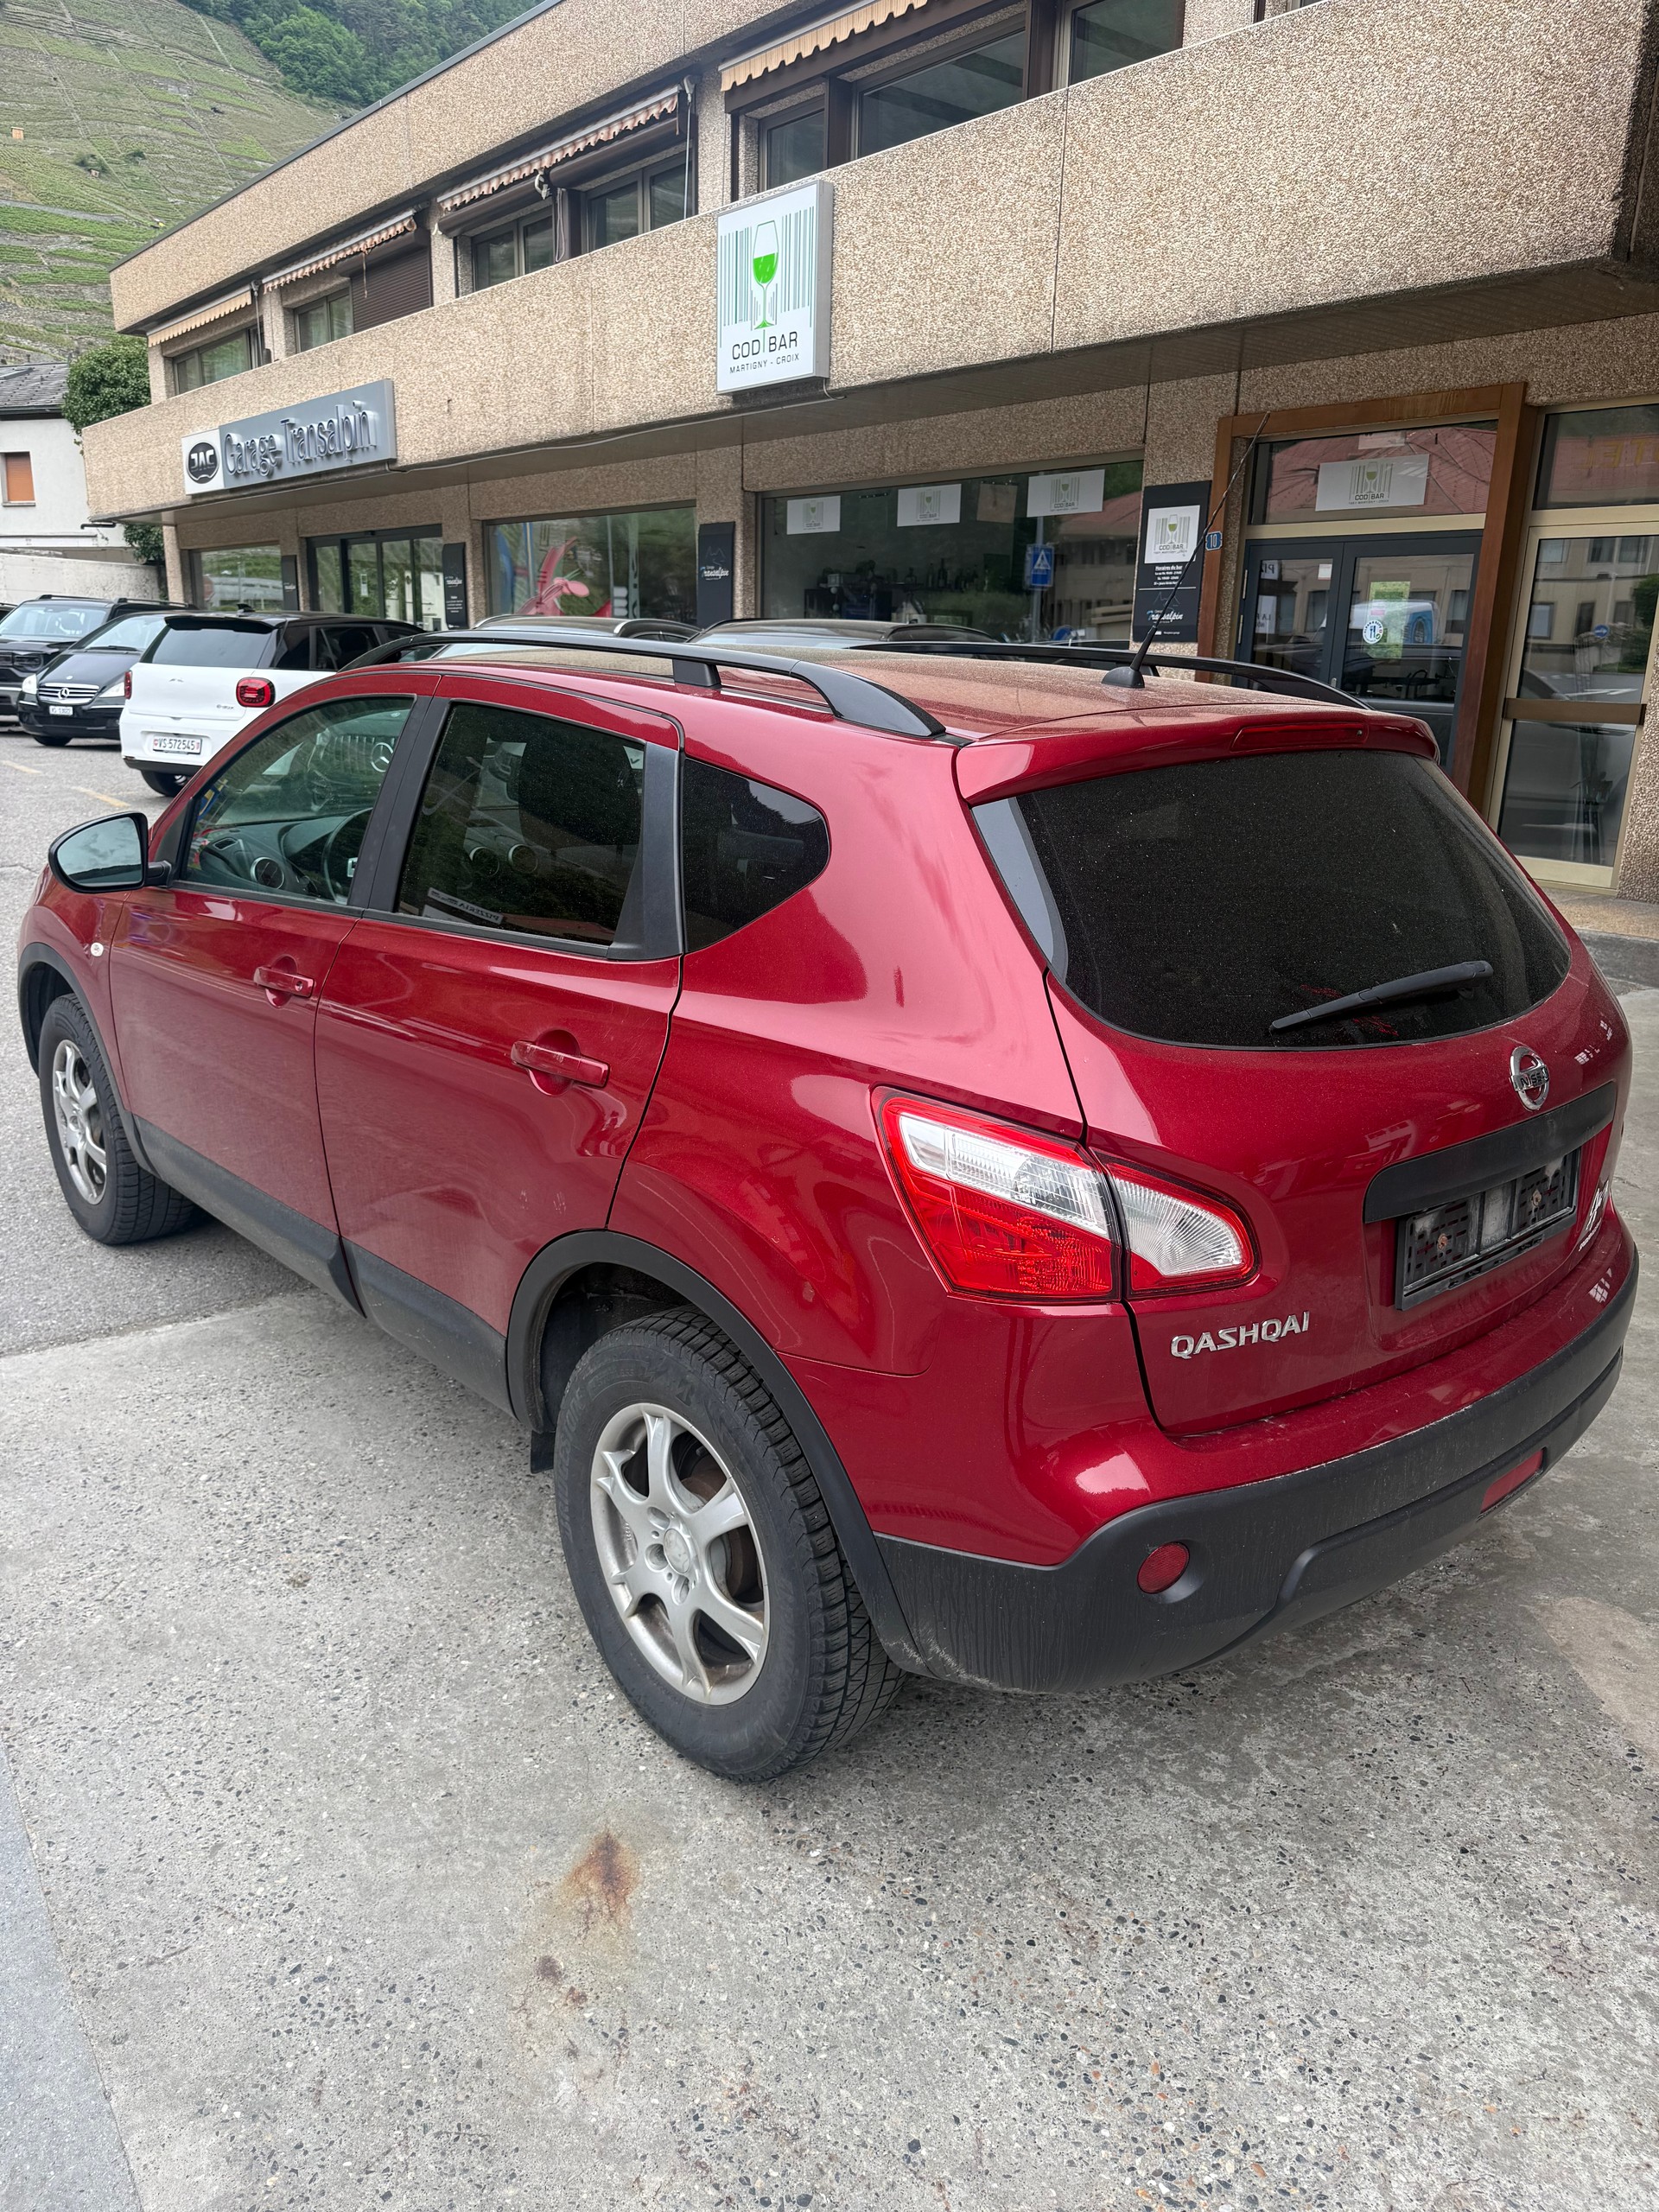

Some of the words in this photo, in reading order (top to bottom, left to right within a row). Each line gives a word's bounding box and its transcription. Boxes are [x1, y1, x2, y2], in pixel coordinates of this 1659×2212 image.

[732, 339, 760, 360] COD
[768, 331, 798, 353] BAR
[729, 359, 767, 373] MARTIGNY
[776, 353, 799, 365] CROIX
[225, 433, 283, 476] Garage
[280, 400, 379, 464] Transalpin
[190, 449, 215, 469] JAC
[1210, 533, 1217, 549] 10
[1171, 1311, 1310, 1359] QASHQAI
